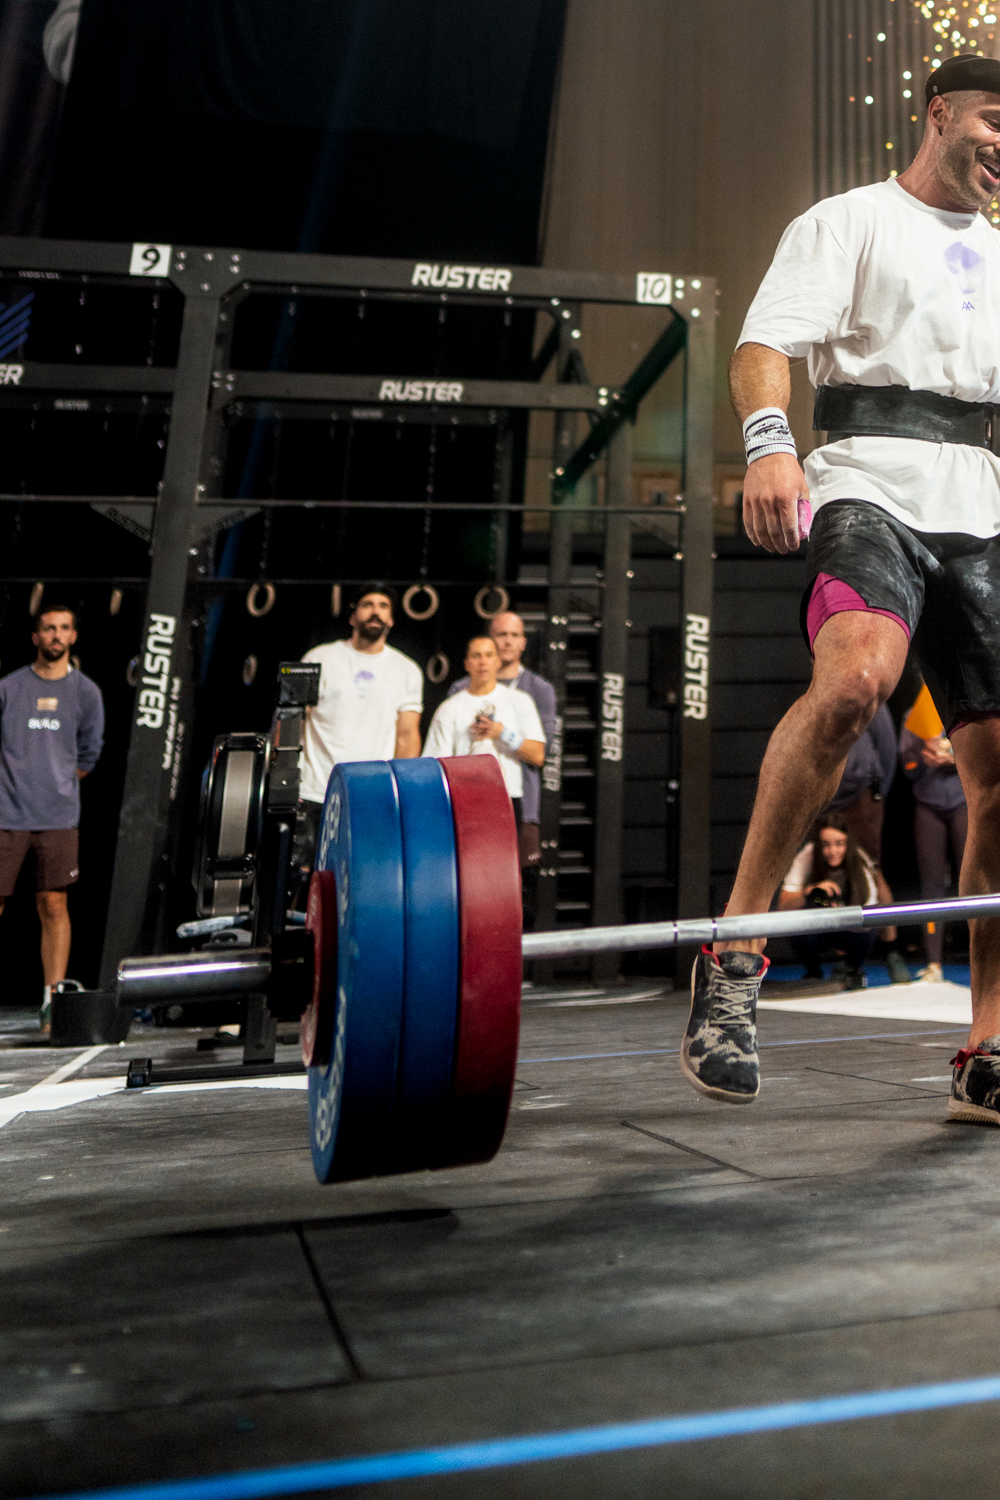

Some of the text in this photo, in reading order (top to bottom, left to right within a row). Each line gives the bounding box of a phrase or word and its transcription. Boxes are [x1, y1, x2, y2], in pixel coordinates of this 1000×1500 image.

[141, 246, 161, 273] 9
[411, 263, 512, 292] RUSTER
[641, 277, 667, 300] 10
[379, 380, 464, 403] RUSTER
[136, 613, 177, 729] RUSTER
[683, 613, 710, 721] RUSTER
[601, 672, 624, 762] RUSTER
